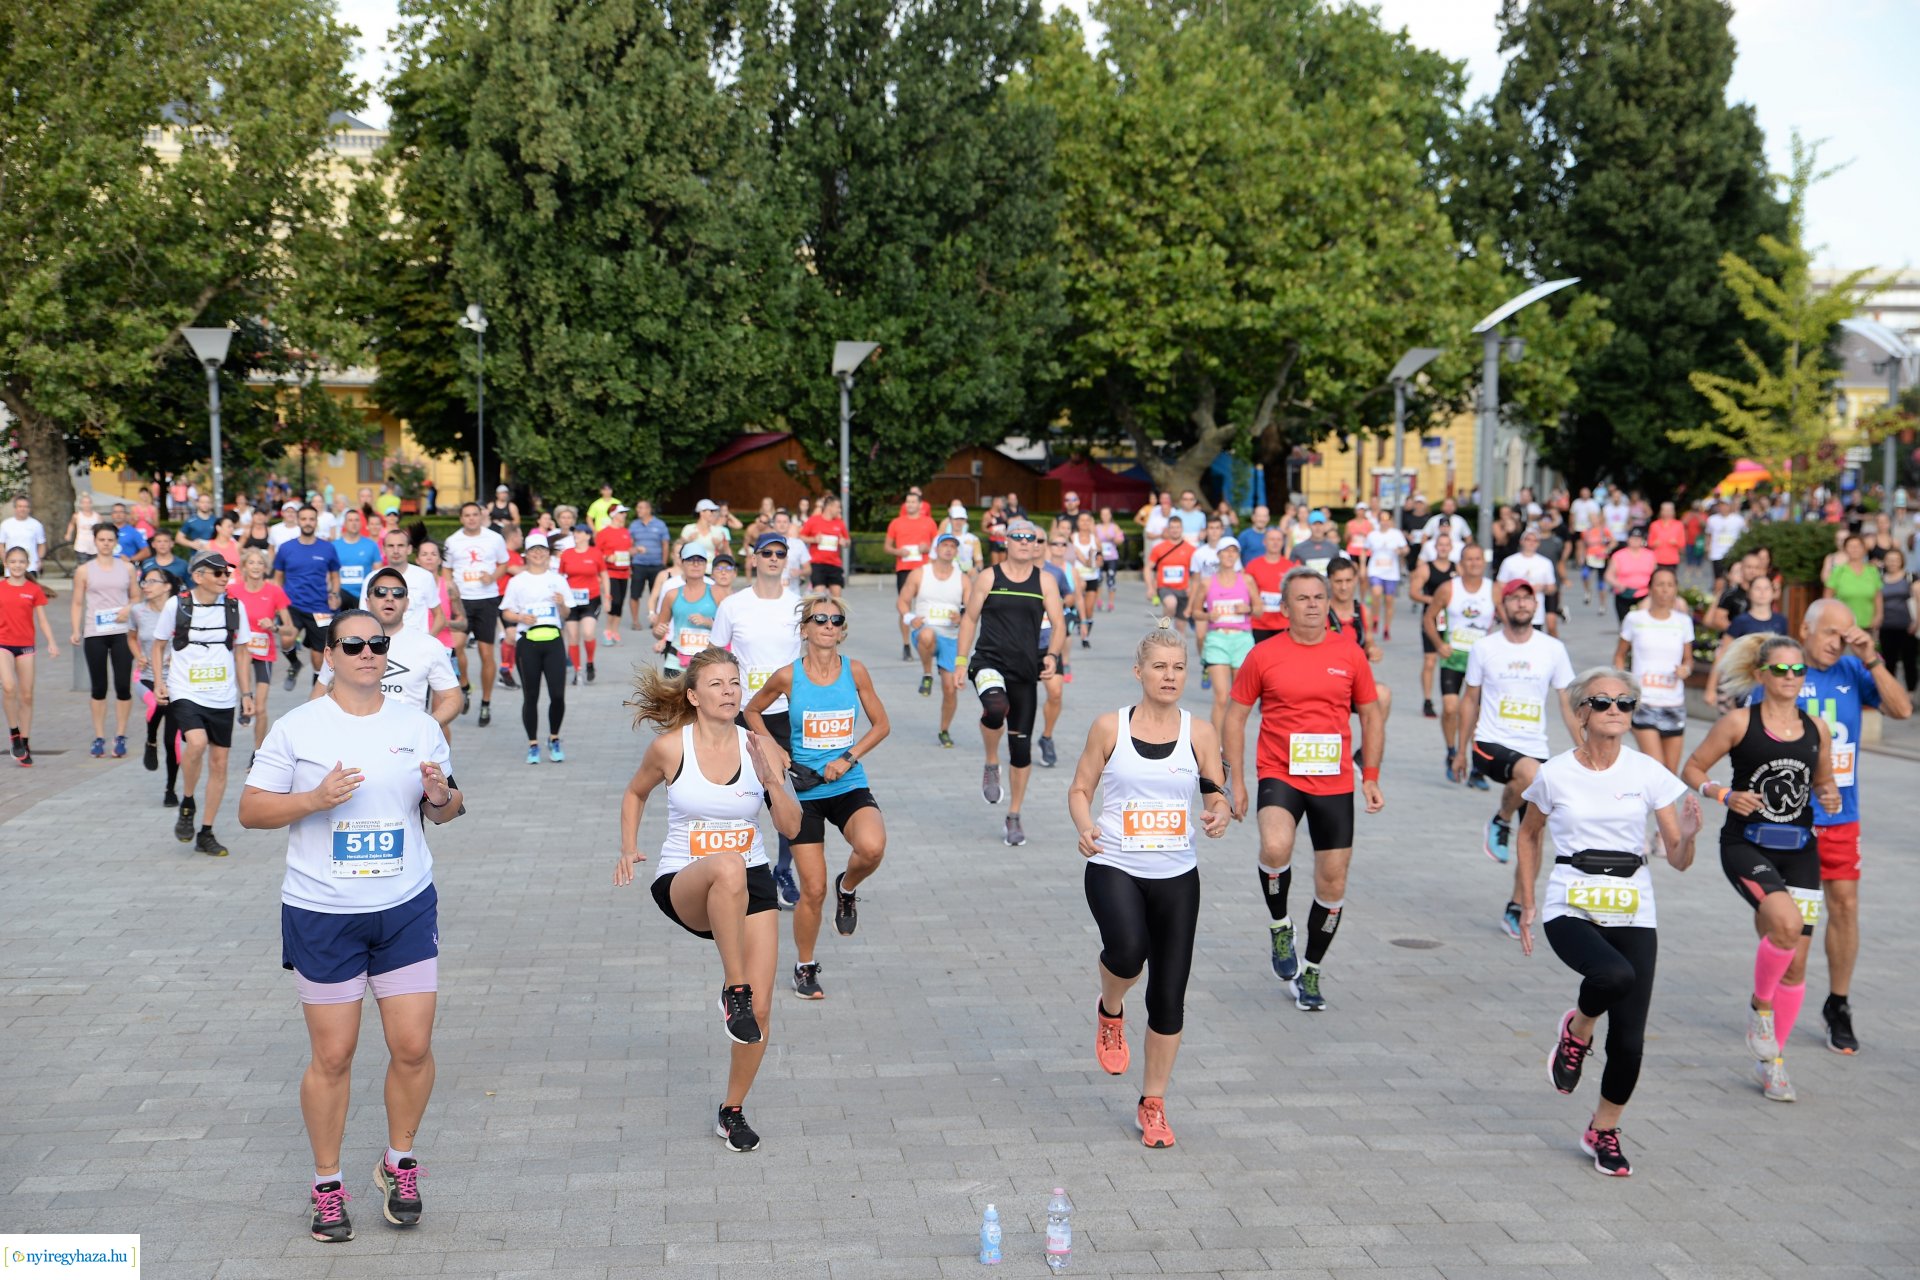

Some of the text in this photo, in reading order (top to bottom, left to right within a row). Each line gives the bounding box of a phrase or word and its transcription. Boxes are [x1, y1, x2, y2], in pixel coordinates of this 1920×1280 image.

[191, 667, 224, 679] 2285
[380, 684, 403, 694] bro
[808, 719, 850, 734] 1094
[1295, 743, 1337, 758] 2150
[1128, 811, 1182, 829] 1059
[346, 832, 394, 852] 519
[696, 830, 749, 849] 1058
[1574, 889, 1633, 907] 2119
